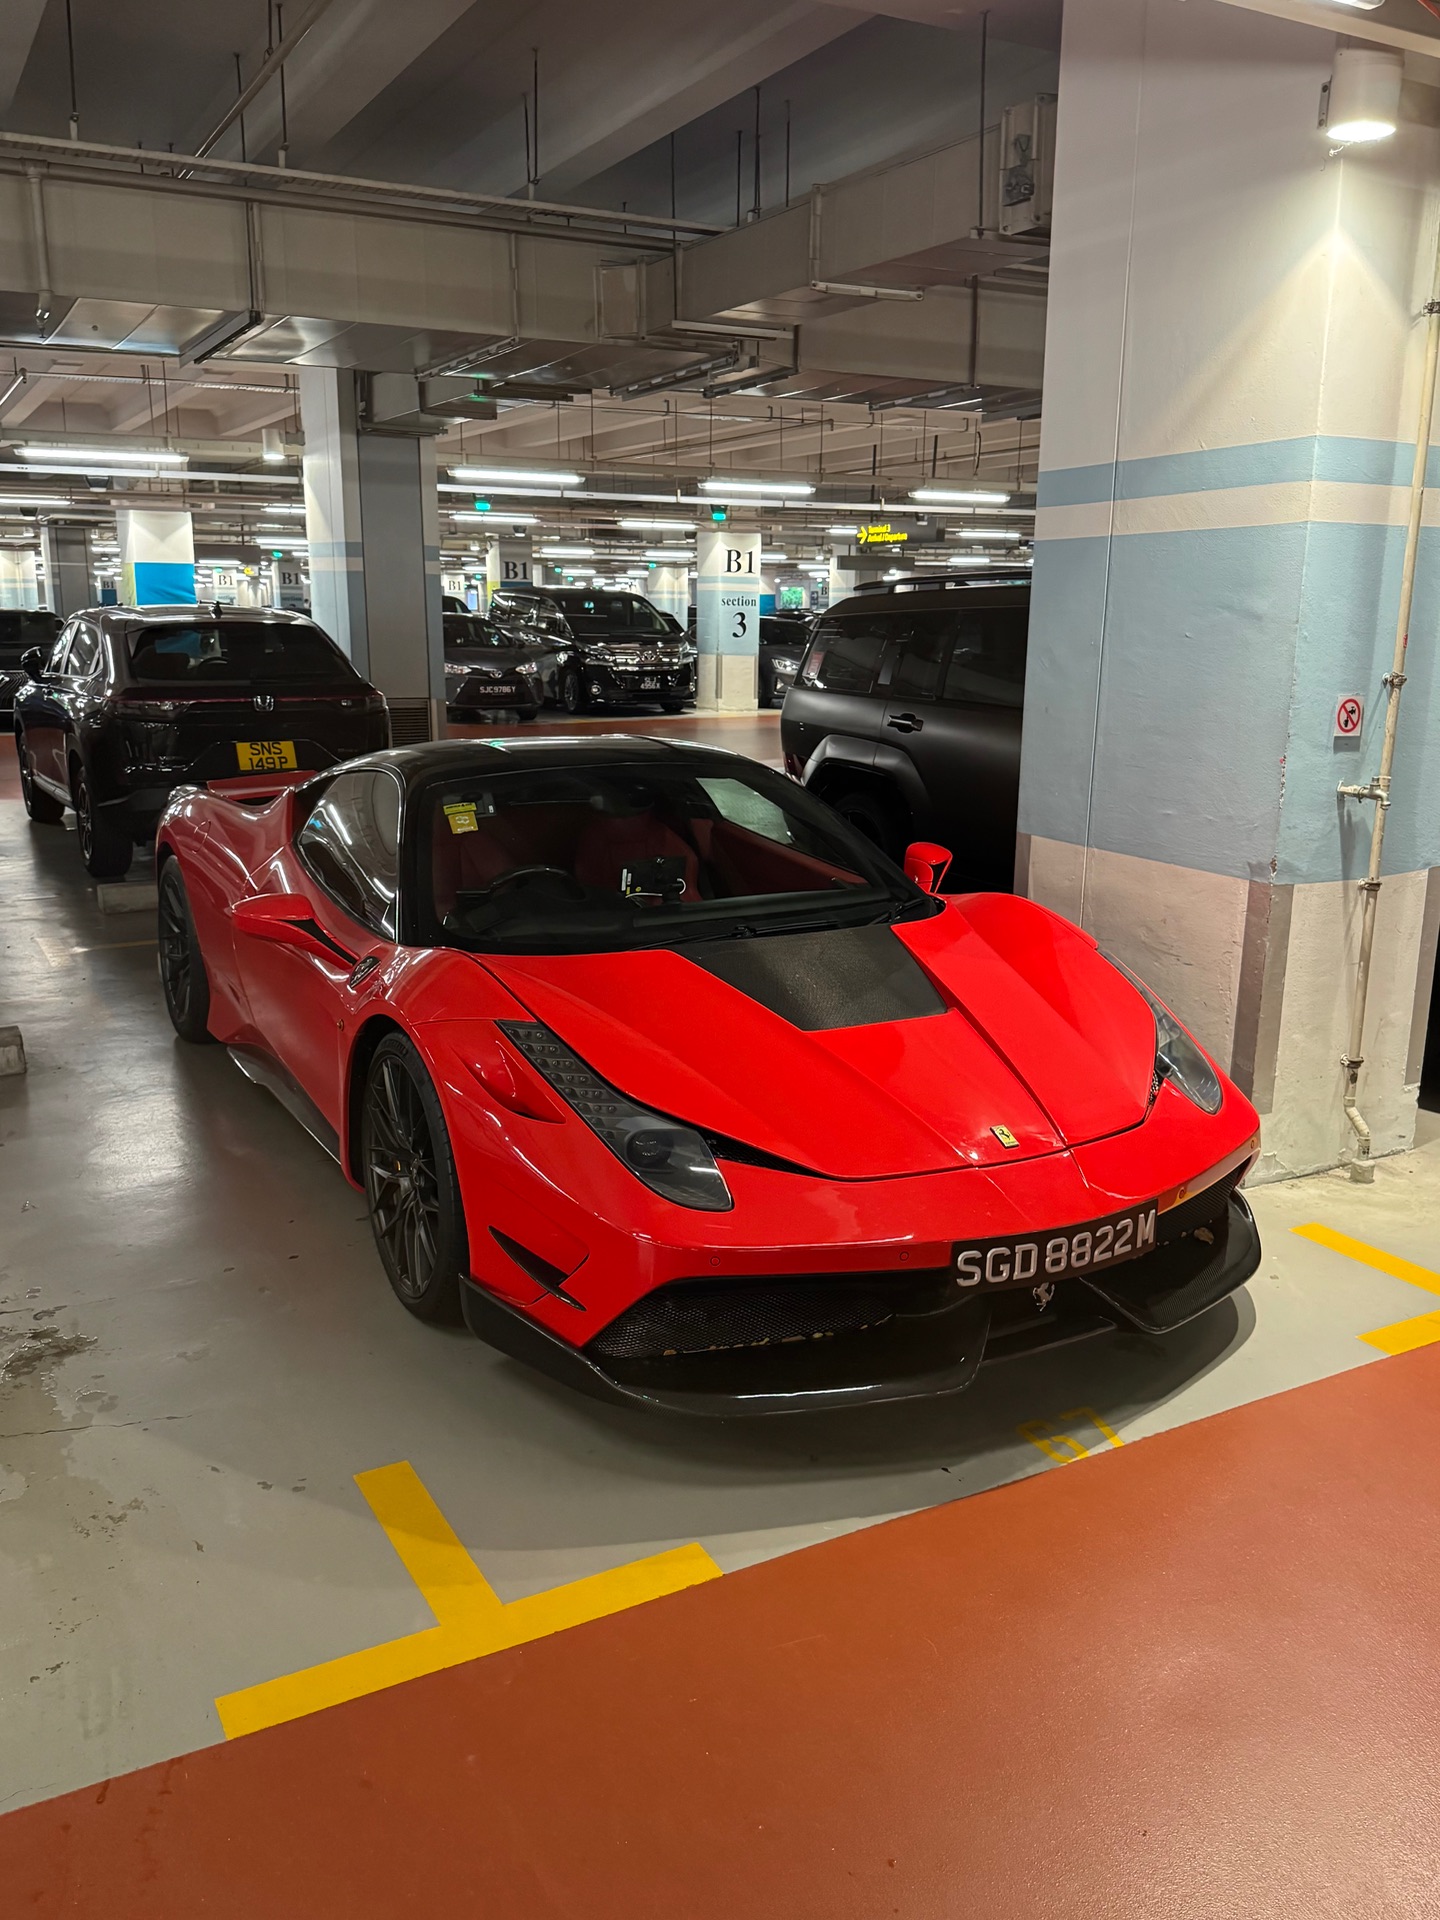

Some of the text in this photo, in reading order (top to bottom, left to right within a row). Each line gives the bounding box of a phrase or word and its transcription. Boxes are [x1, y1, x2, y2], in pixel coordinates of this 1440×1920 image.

[725, 549, 756, 574] B1
[504, 561, 529, 580] B1
[103, 580, 114, 589] B1
[218, 575, 234, 586] B1
[282, 572, 300, 585] B1
[448, 581, 462, 591] B1
[721, 596, 757, 607] section
[732, 612, 747, 638] 3
[249, 742, 283, 756] SNS
[248, 756, 288, 770] 149P
[1017, 1406, 1125, 1464] 67
